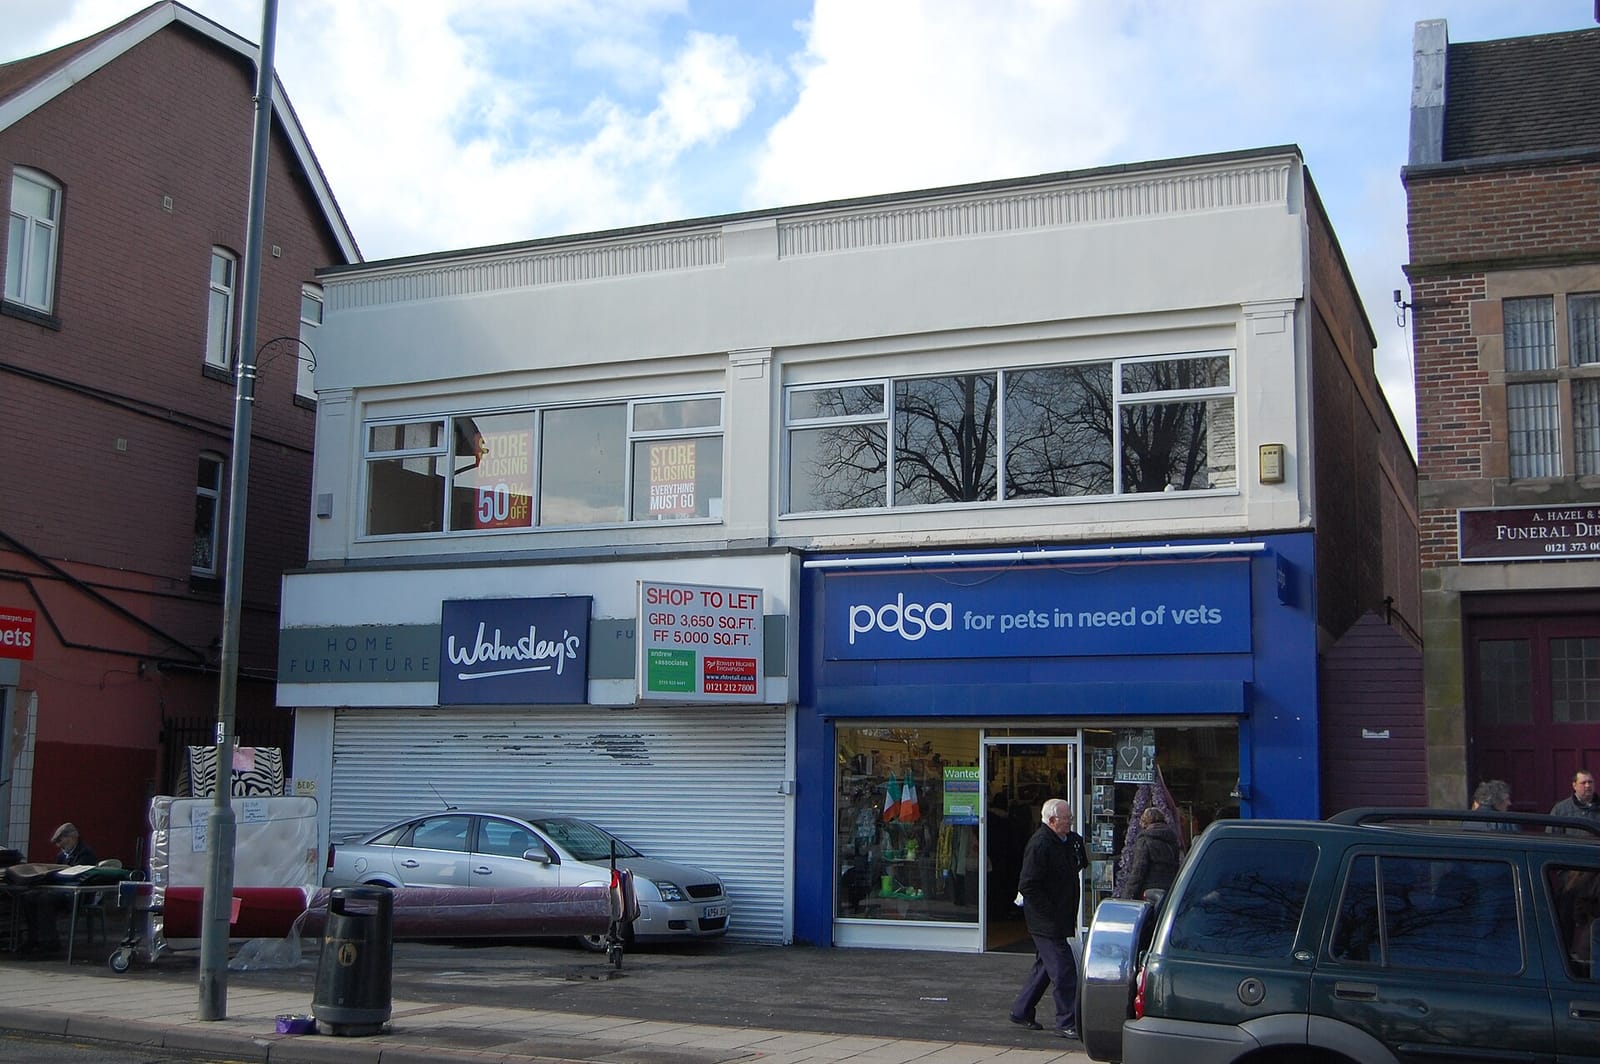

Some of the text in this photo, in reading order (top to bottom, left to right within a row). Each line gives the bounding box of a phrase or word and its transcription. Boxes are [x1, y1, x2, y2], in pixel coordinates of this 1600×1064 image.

[650, 443, 696, 466] STORE
[479, 456, 528, 478] CLOSING
[650, 464, 696, 482] CLOSING
[650, 482, 695, 495] EVERYTHING
[650, 493, 694, 511] MUST GO
[510, 505, 528, 520] OFF
[1533, 513, 1544, 521] A.
[1548, 511, 1584, 520] HAZEL
[1587, 510, 1595, 519] &
[1496, 525, 1570, 540] FUNERAL
[1545, 543, 1566, 552] 0121
[1570, 542, 1587, 551] 373
[646, 587, 758, 610] SHOP TO LET
[649, 613, 756, 631] GRD 3,650 SQ.FT.
[849, 592, 1223, 645] pdsa for pets in need of vets
[327, 637, 393, 652] HOME
[653, 629, 751, 646] FF 5,000 SQ.FT.
[448, 622, 580, 675] Walmsley's
[290, 657, 430, 673] FURNITURE
[706, 683, 722, 691] 0121
[723, 683, 737, 692] 212
